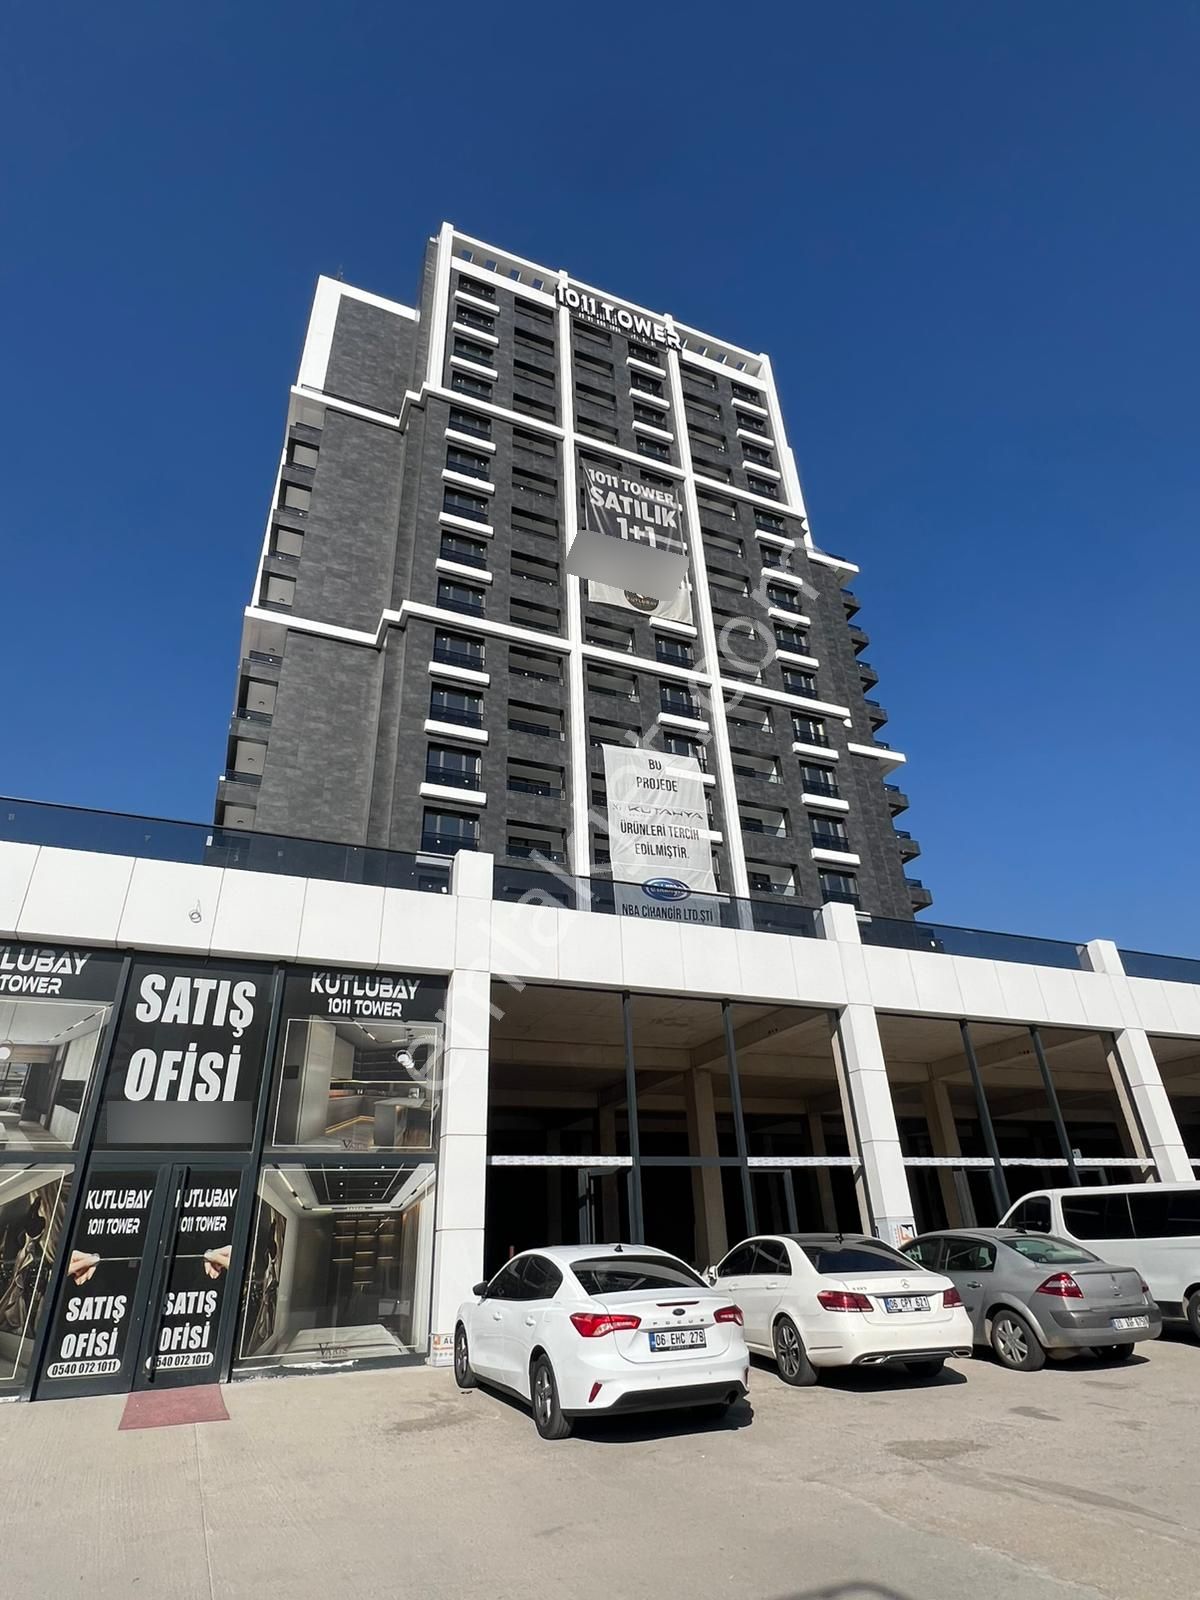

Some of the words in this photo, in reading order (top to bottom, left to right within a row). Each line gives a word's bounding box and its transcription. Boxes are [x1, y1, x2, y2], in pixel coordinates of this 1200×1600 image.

[557, 284, 596, 316] 1011
[601, 302, 683, 351] TOWER
[588, 468, 618, 489] 1011
[621, 479, 674, 504] TOWER
[590, 485, 677, 528] SATILIK
[616, 517, 657, 548] 1+1
[648, 759, 662, 770] BU
[636, 776, 679, 792] PROJEDE
[620, 819, 667, 836] ÜRÜNLERİ
[668, 823, 700, 841] TERCİH
[622, 903, 640, 916] NBA
[641, 904, 682, 919] CİHANGİR
[0, 946, 92, 975] LUBAY
[0, 974, 62, 994] TOWER
[310, 971, 420, 1000] KUTLUBAY
[135, 973, 257, 1038] SATIŞ
[328, 998, 351, 1014] 1011
[354, 999, 402, 1017] TOWER
[123, 1042, 242, 1102] OFİSİ
[85, 1189, 153, 1210] KUTLUBAY
[87, 1218, 105, 1235] 1011
[106, 1217, 140, 1235] TOWER
[180, 1216, 194, 1232] 011
[195, 1216, 227, 1232] TOWER
[66, 1295, 127, 1324] SATIŞ
[165, 1290, 218, 1318] SATIŞ
[60, 1327, 119, 1359] OFİSİ
[159, 1321, 211, 1351] OFİSİ
[656, 1334, 667, 1346] 06
[670, 1332, 686, 1345] EHC
[52, 1363, 77, 1376] 0540
[78, 1361, 95, 1375] 072
[96, 1360, 117, 1372] 1011
[154, 1355, 173, 1368] 540
[174, 1354, 191, 1367] 072
[192, 1353, 210, 1365] 1011
